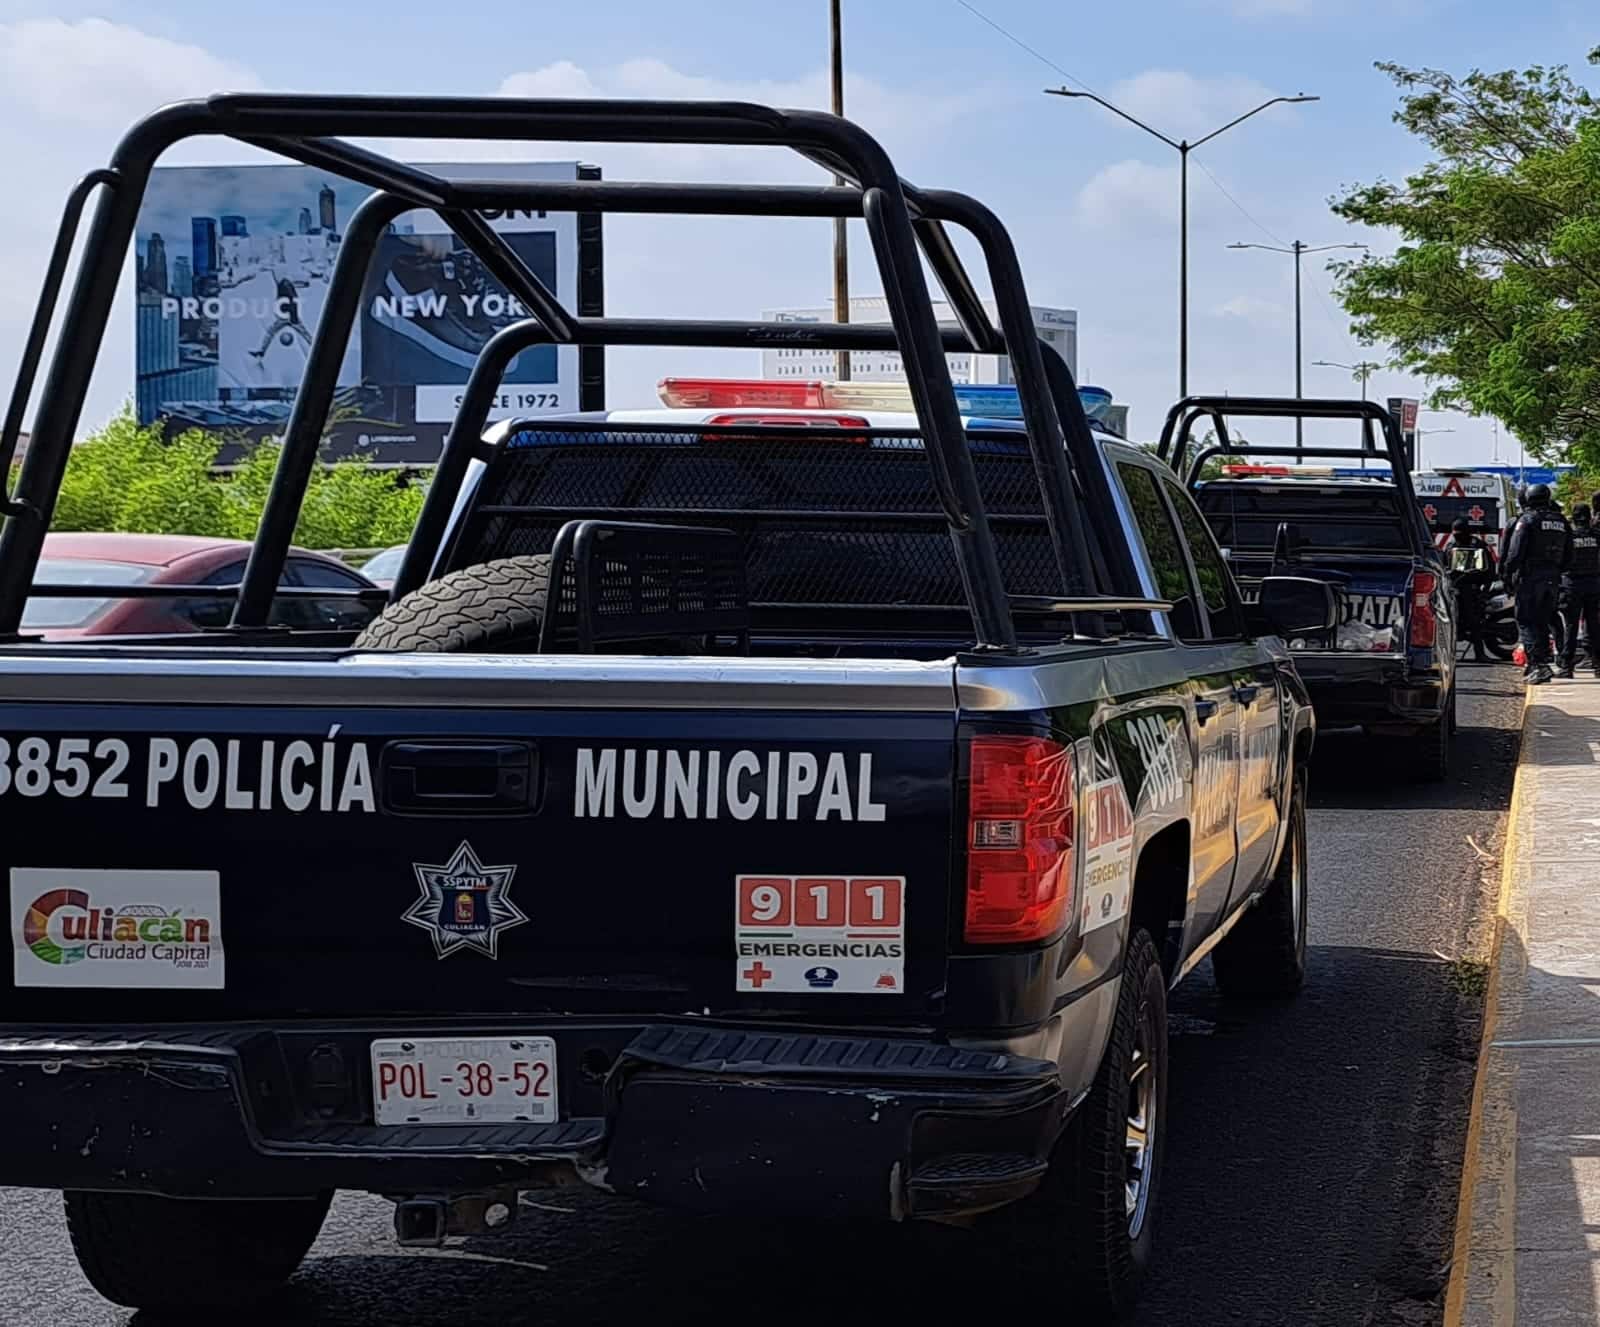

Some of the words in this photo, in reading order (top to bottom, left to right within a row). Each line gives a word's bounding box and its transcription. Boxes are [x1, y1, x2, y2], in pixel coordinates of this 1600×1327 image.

[375, 295, 447, 317] NEW
[459, 294, 533, 317] YOR
[517, 393, 559, 409] 1972
[146, 724, 376, 812] POLICÍA
[574, 748, 886, 821] MUNICIPAL
[24, 888, 210, 965] Culiacán
[87, 943, 146, 960] Ciudad
[152, 944, 210, 964] Capital
[739, 943, 902, 958] EMERGENCIAS
[379, 1062, 551, 1101] POL-38-52
